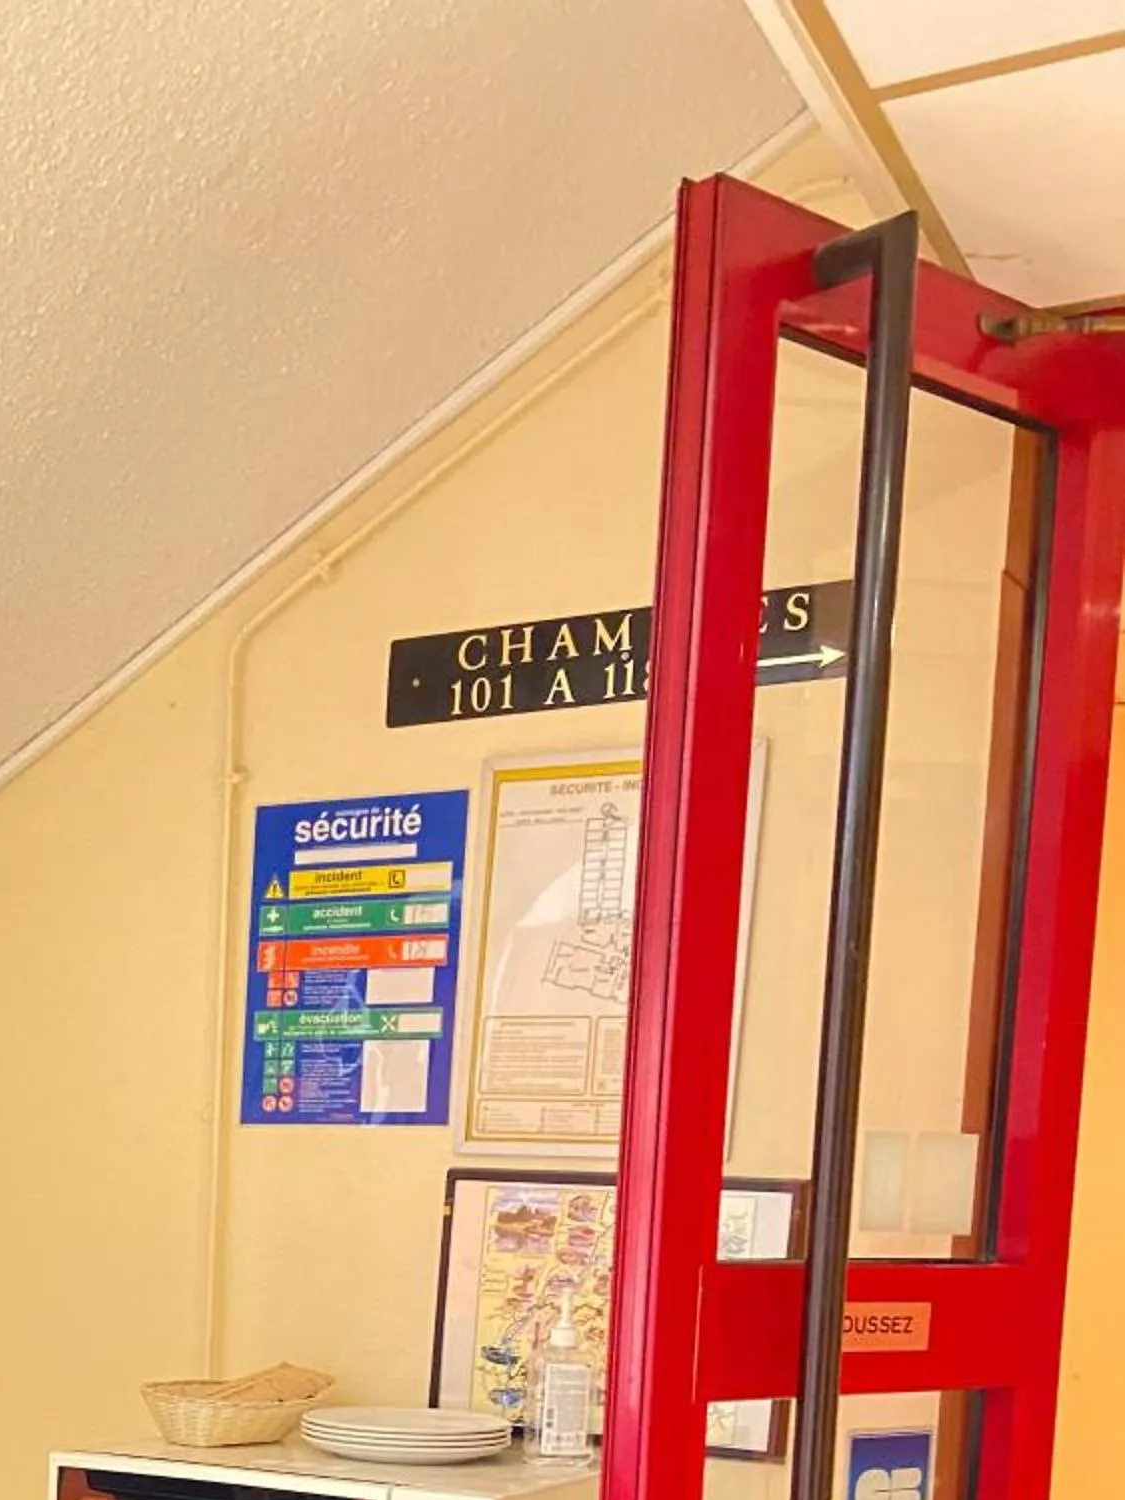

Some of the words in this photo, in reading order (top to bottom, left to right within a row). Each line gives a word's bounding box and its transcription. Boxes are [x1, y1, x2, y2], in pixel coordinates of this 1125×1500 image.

[450, 672, 514, 716] 101
[544, 675, 576, 705] A
[602, 659, 651, 699] 11
[294, 803, 422, 843] sécurité
[315, 871, 363, 884] incident
[312, 905, 363, 918] accident
[842, 1315, 914, 1334] OUSSEZ
